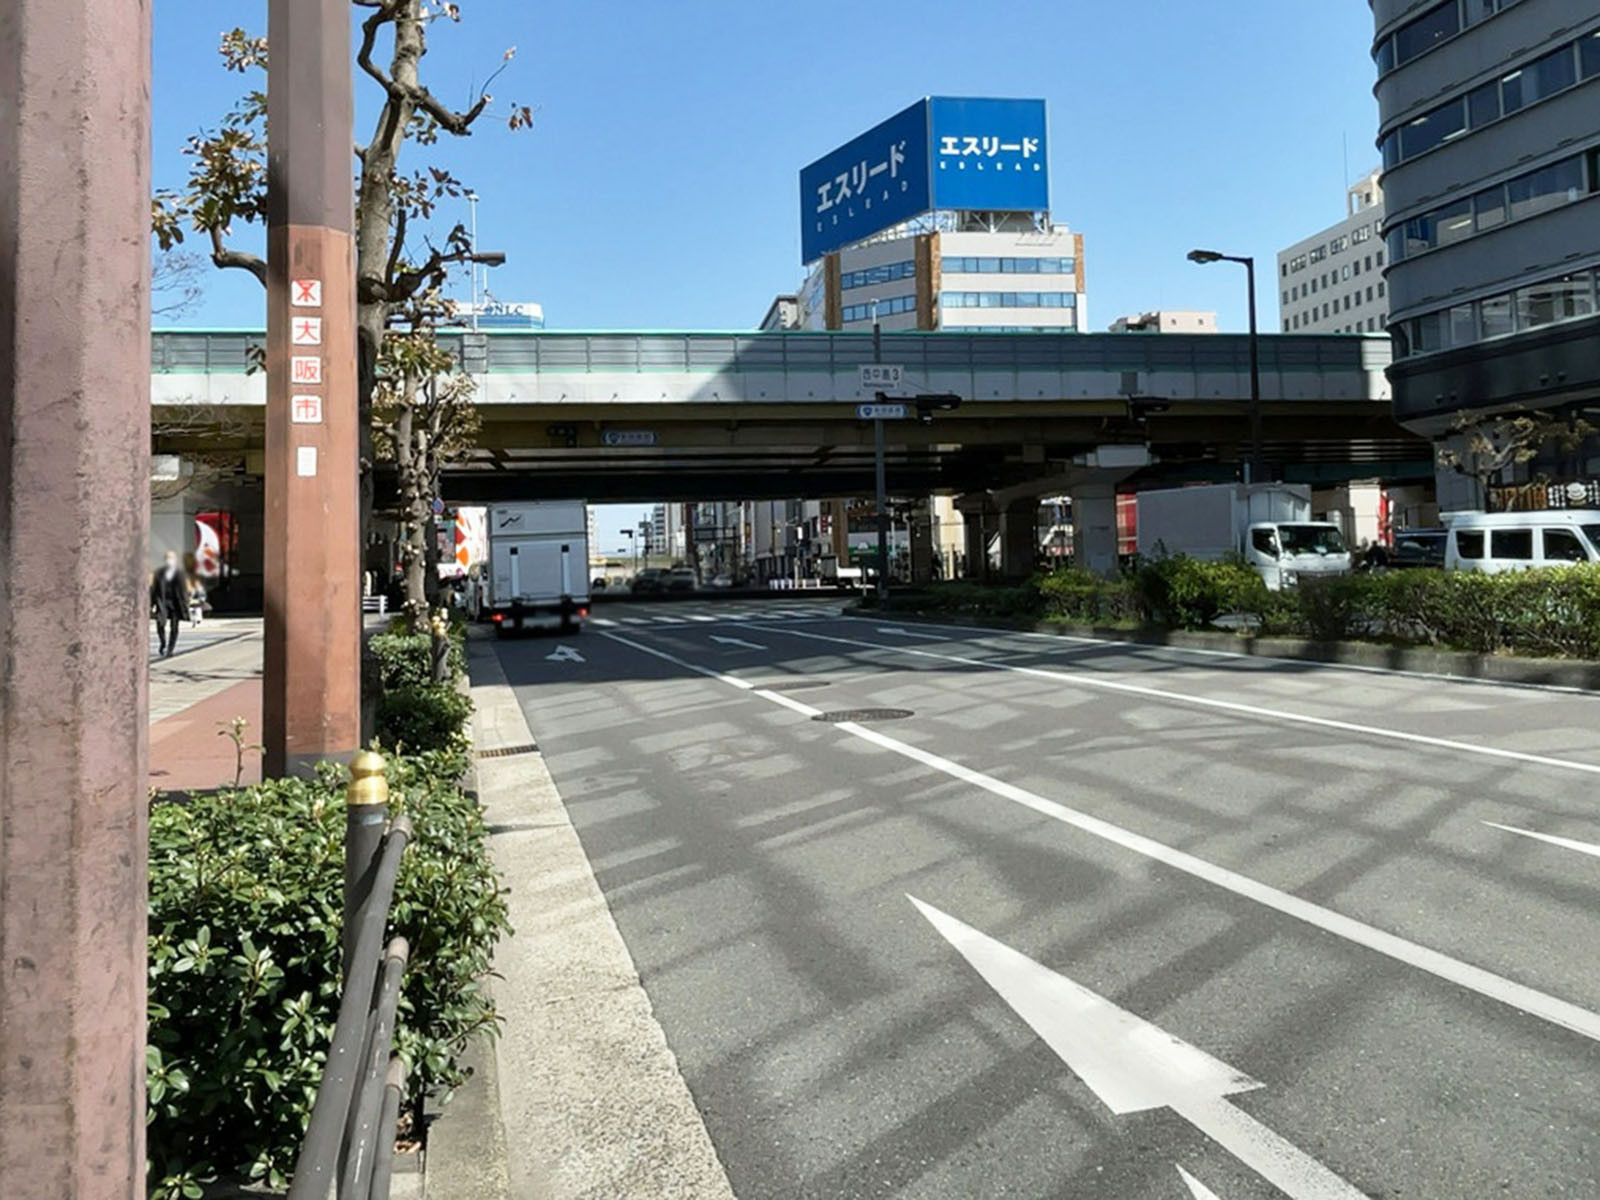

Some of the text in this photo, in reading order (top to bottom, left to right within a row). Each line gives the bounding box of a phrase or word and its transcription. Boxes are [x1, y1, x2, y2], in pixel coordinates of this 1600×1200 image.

[816, 140, 906, 213] エスリード
[939, 136, 1039, 158] エスリード
[295, 320, 319, 420] 大阪市
